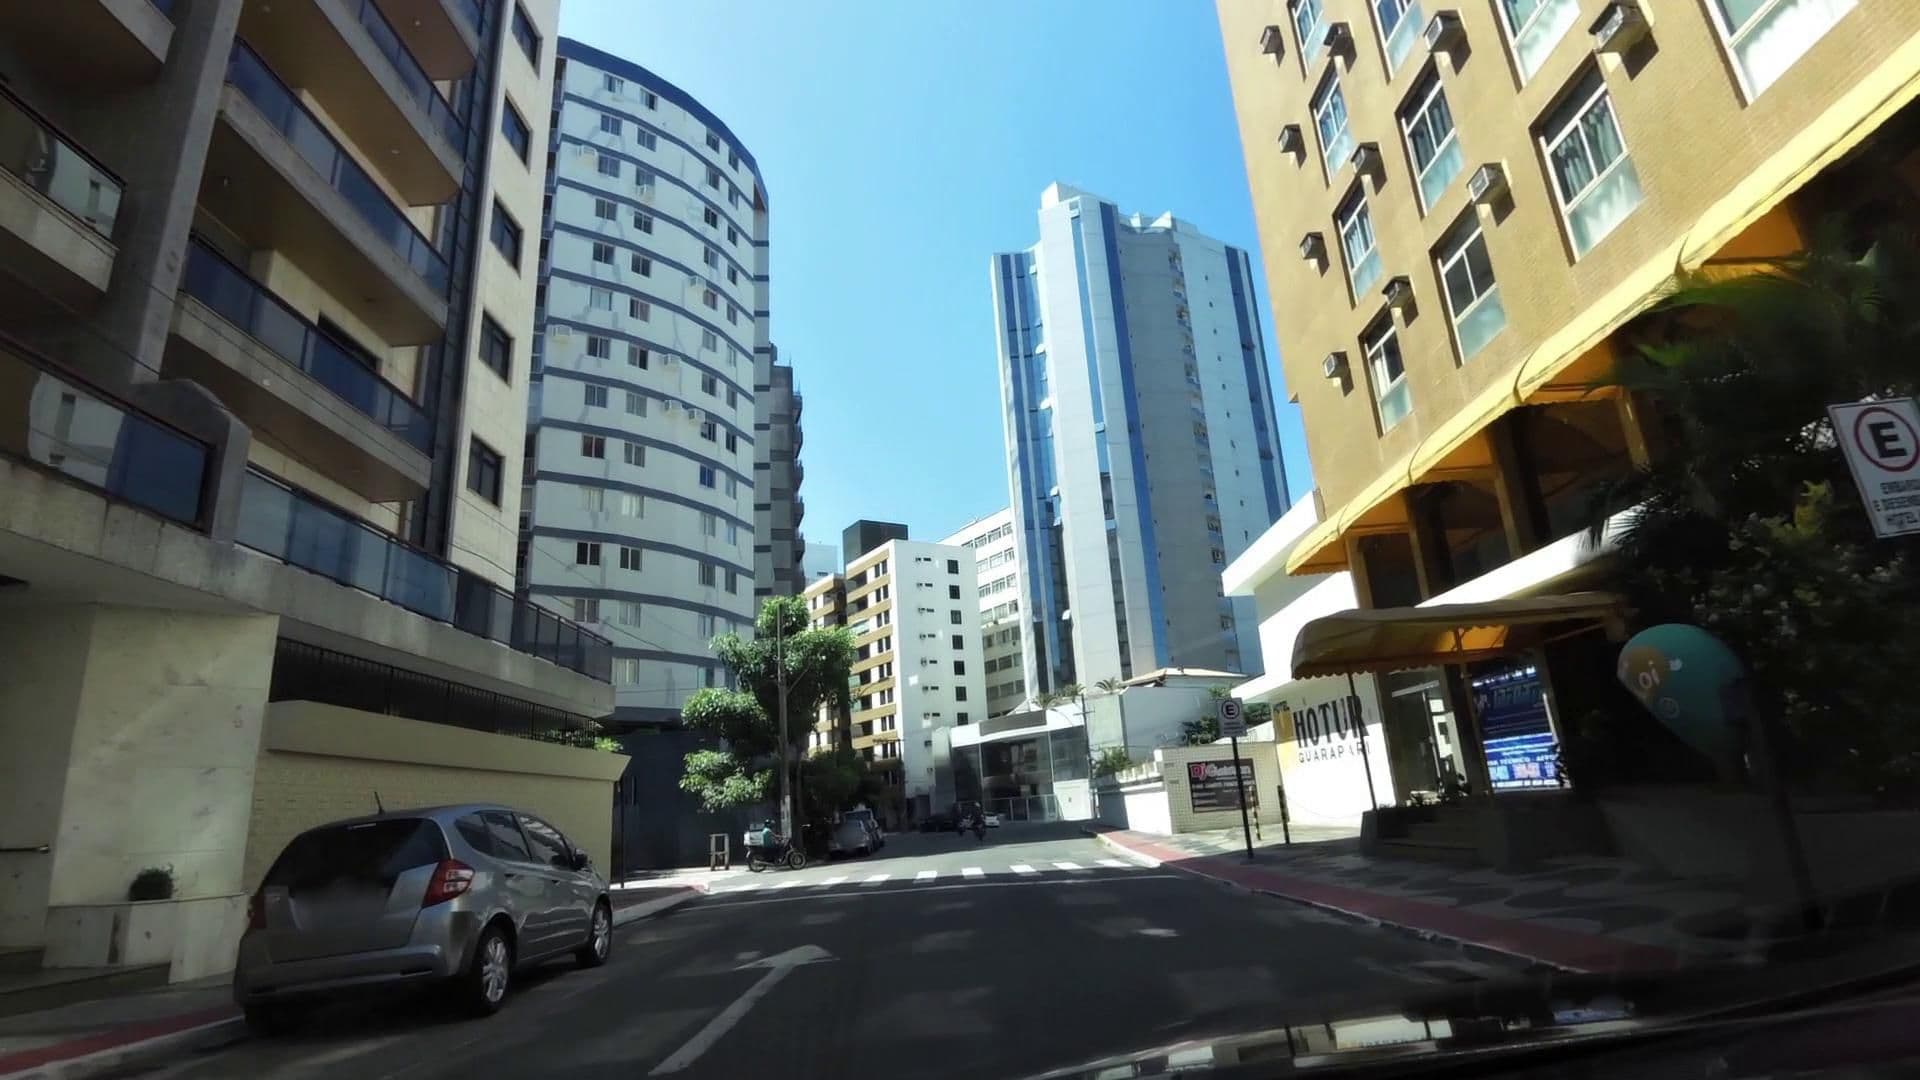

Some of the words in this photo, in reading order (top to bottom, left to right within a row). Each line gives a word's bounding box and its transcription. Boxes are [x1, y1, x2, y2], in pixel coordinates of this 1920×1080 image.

[1868, 421, 1908, 458] E
[1639, 660, 1660, 688] oi
[1225, 703, 1236, 716] E
[1293, 695, 1370, 748] HOTUR
